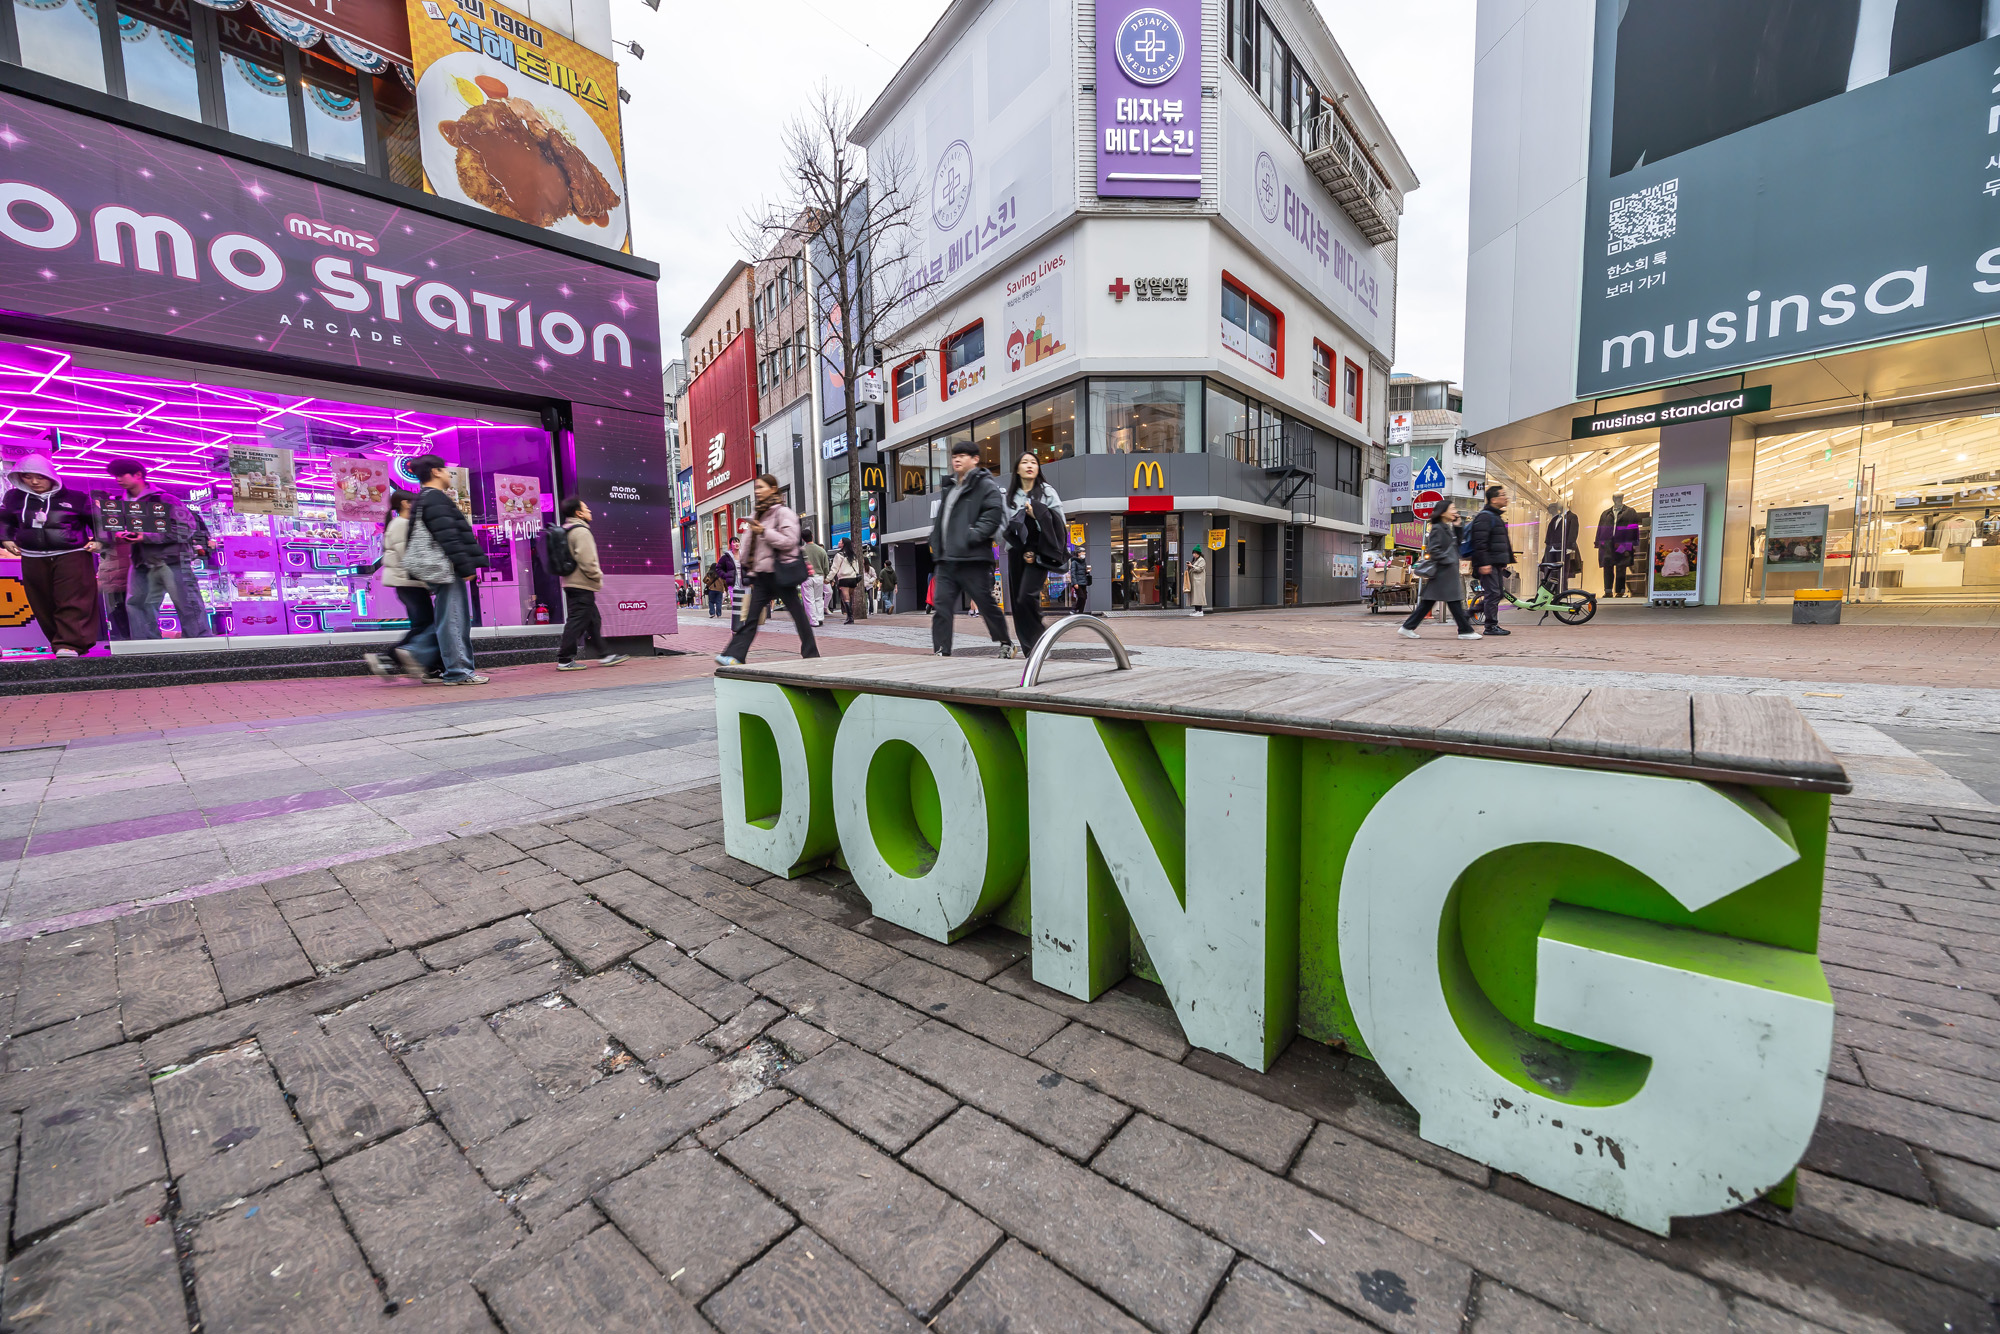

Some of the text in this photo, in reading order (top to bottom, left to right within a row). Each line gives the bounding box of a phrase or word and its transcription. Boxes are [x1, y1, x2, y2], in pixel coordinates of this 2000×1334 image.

[490, 8, 543, 49] 1980
[1131, 16, 1169, 32] DEJAVU
[446, 11, 609, 111] 심해돈까스
[1125, 53, 1175, 76] MEDISKIN
[1116, 97, 1185, 124] 데자뷰
[1105, 128, 1194, 155] 메디스킨
[948, 196, 1016, 273] 메디스킨
[1284, 184, 1378, 319] 데자뷰 메디스킨
[1606, 251, 1668, 280] 한소희 룩
[1006, 254, 1066, 297] Saving Lives,
[1134, 277, 1189, 296] 헌혈의집
[1605, 271, 1667, 299] 보러 가기
[280, 314, 402, 346] ARCADE
[1601, 265, 1928, 373] musinsa
[1592, 394, 1744, 431] musinsa standard
[706, 470, 731, 491] new balance
[1391, 480, 1409, 488] 데자뷰
[716, 676, 1836, 1238] DONG
